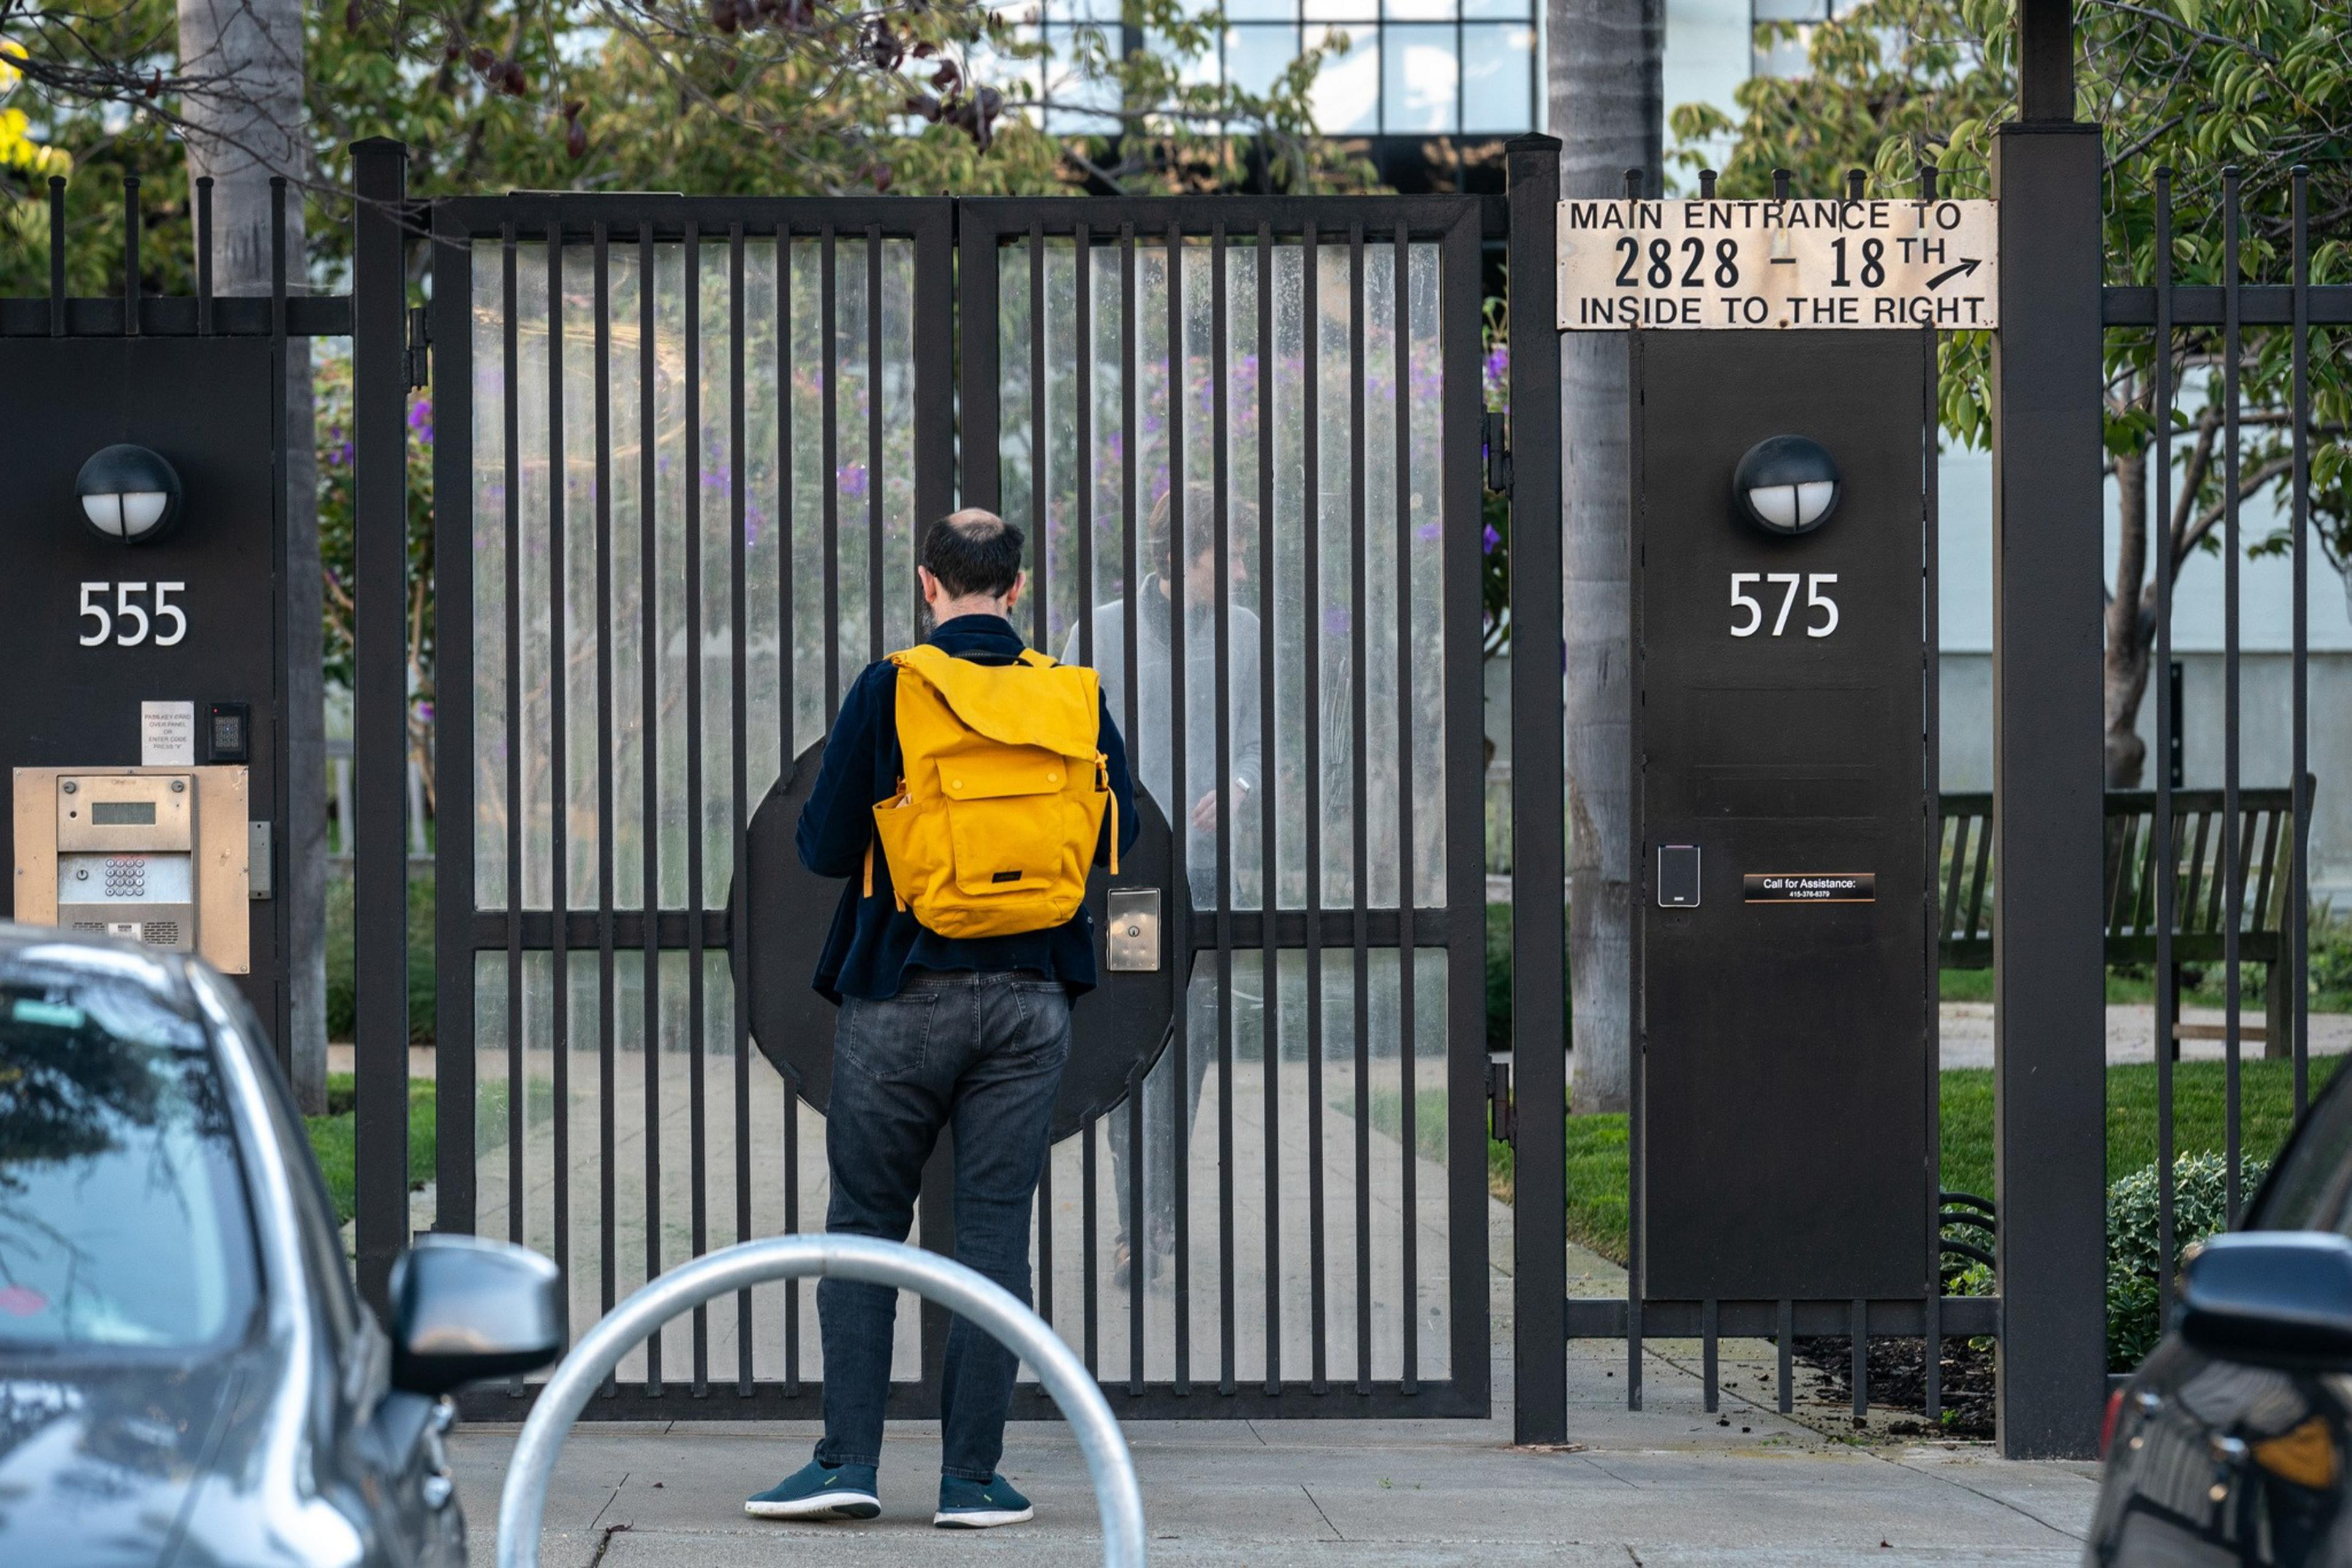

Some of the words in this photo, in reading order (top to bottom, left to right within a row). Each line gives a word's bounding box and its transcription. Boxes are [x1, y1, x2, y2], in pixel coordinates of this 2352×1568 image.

[1571, 202, 1662, 229] MAIN
[1685, 202, 1889, 229] ENTRANCE
[1911, 202, 1961, 229] TO
[1616, 236, 1739, 288] 2828
[1581, 296, 1701, 324] INSIDE
[1720, 297, 1768, 324] TO
[1787, 297, 1859, 323] THE
[1875, 296, 1984, 324] RIGHT
[80, 581, 187, 646] 555
[1730, 573, 1839, 638] 575
[1763, 878, 1783, 889] Call
[1785, 878, 1799, 889] for
[1800, 878, 1856, 889] Assistance:
